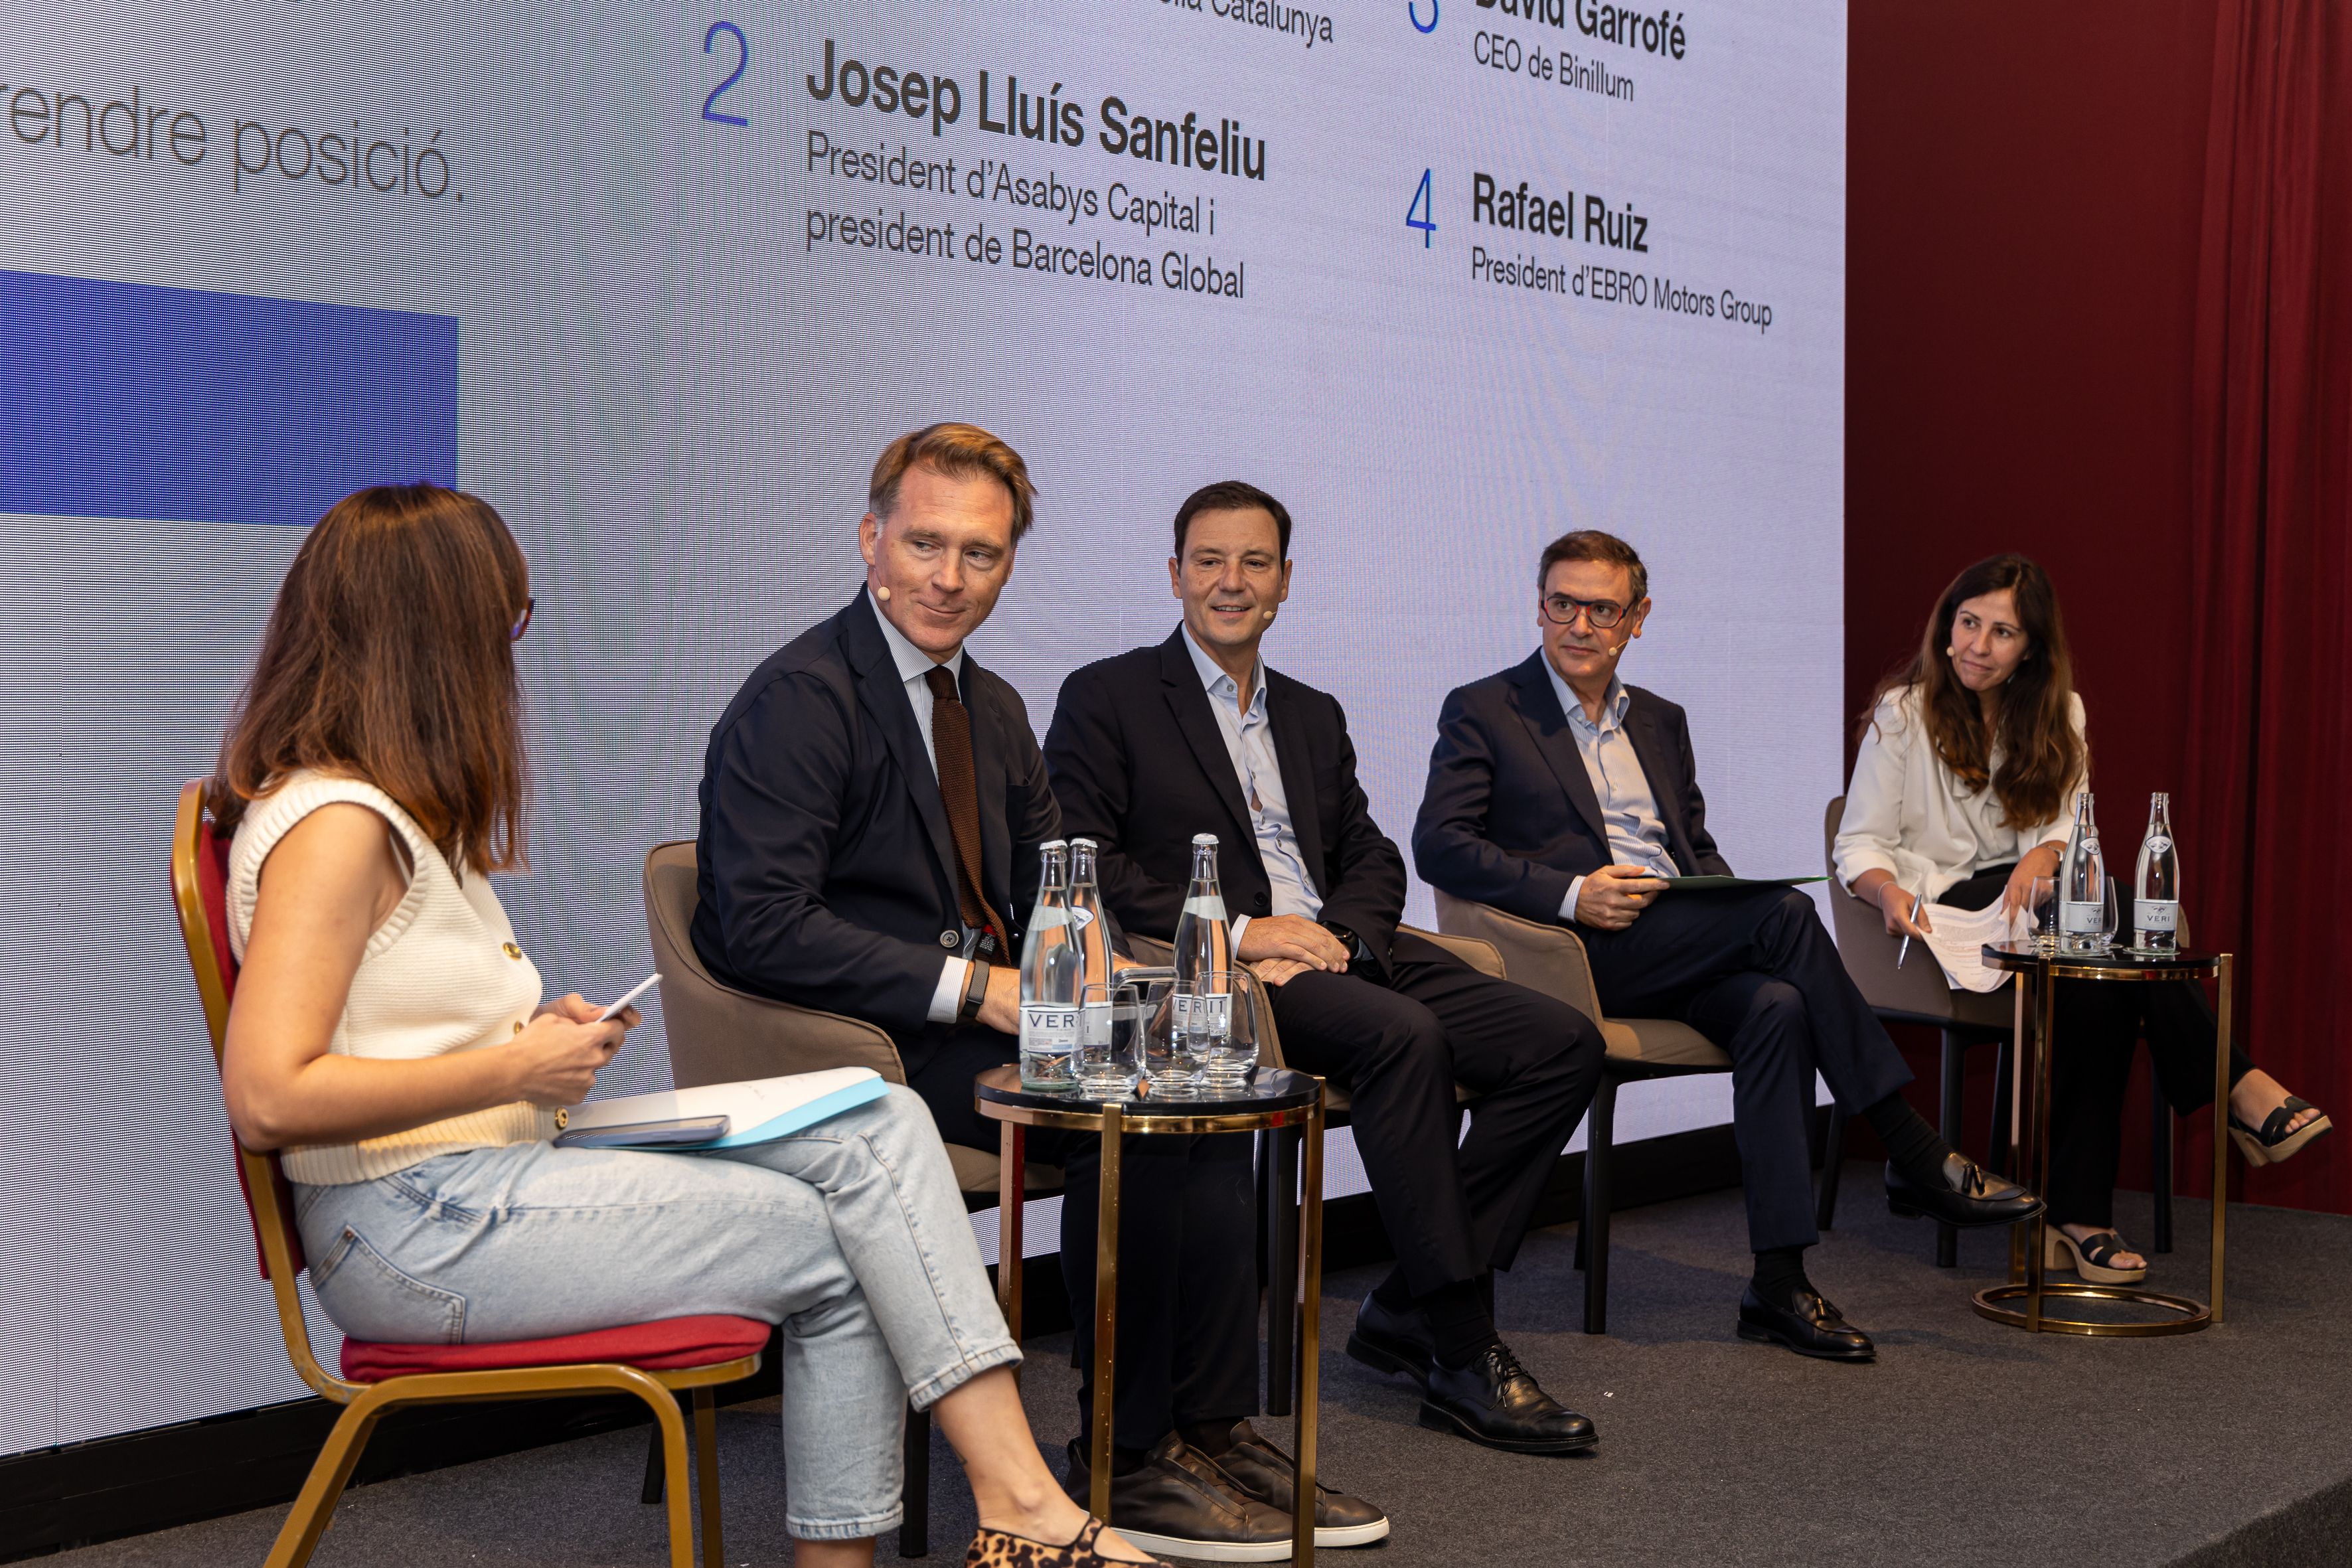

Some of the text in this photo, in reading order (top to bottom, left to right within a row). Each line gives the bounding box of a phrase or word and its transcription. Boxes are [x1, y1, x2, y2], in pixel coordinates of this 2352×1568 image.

[1474, 31, 1634, 102] CEO de Binillum
[1575, 0, 1686, 60] Garrofé
[703, 21, 748, 126] 2
[807, 38, 1265, 181] Josep Lluís Sanfeliu
[233, 118, 463, 202] posició.
[807, 129, 1214, 237] President d’Asabys Capital i
[1405, 168, 1437, 249] 4
[1473, 172, 1648, 253] Rafael Ruiz
[807, 208, 1244, 299] president de Barcelona Global
[1472, 246, 1772, 335] President d’EBRO Motors Group
